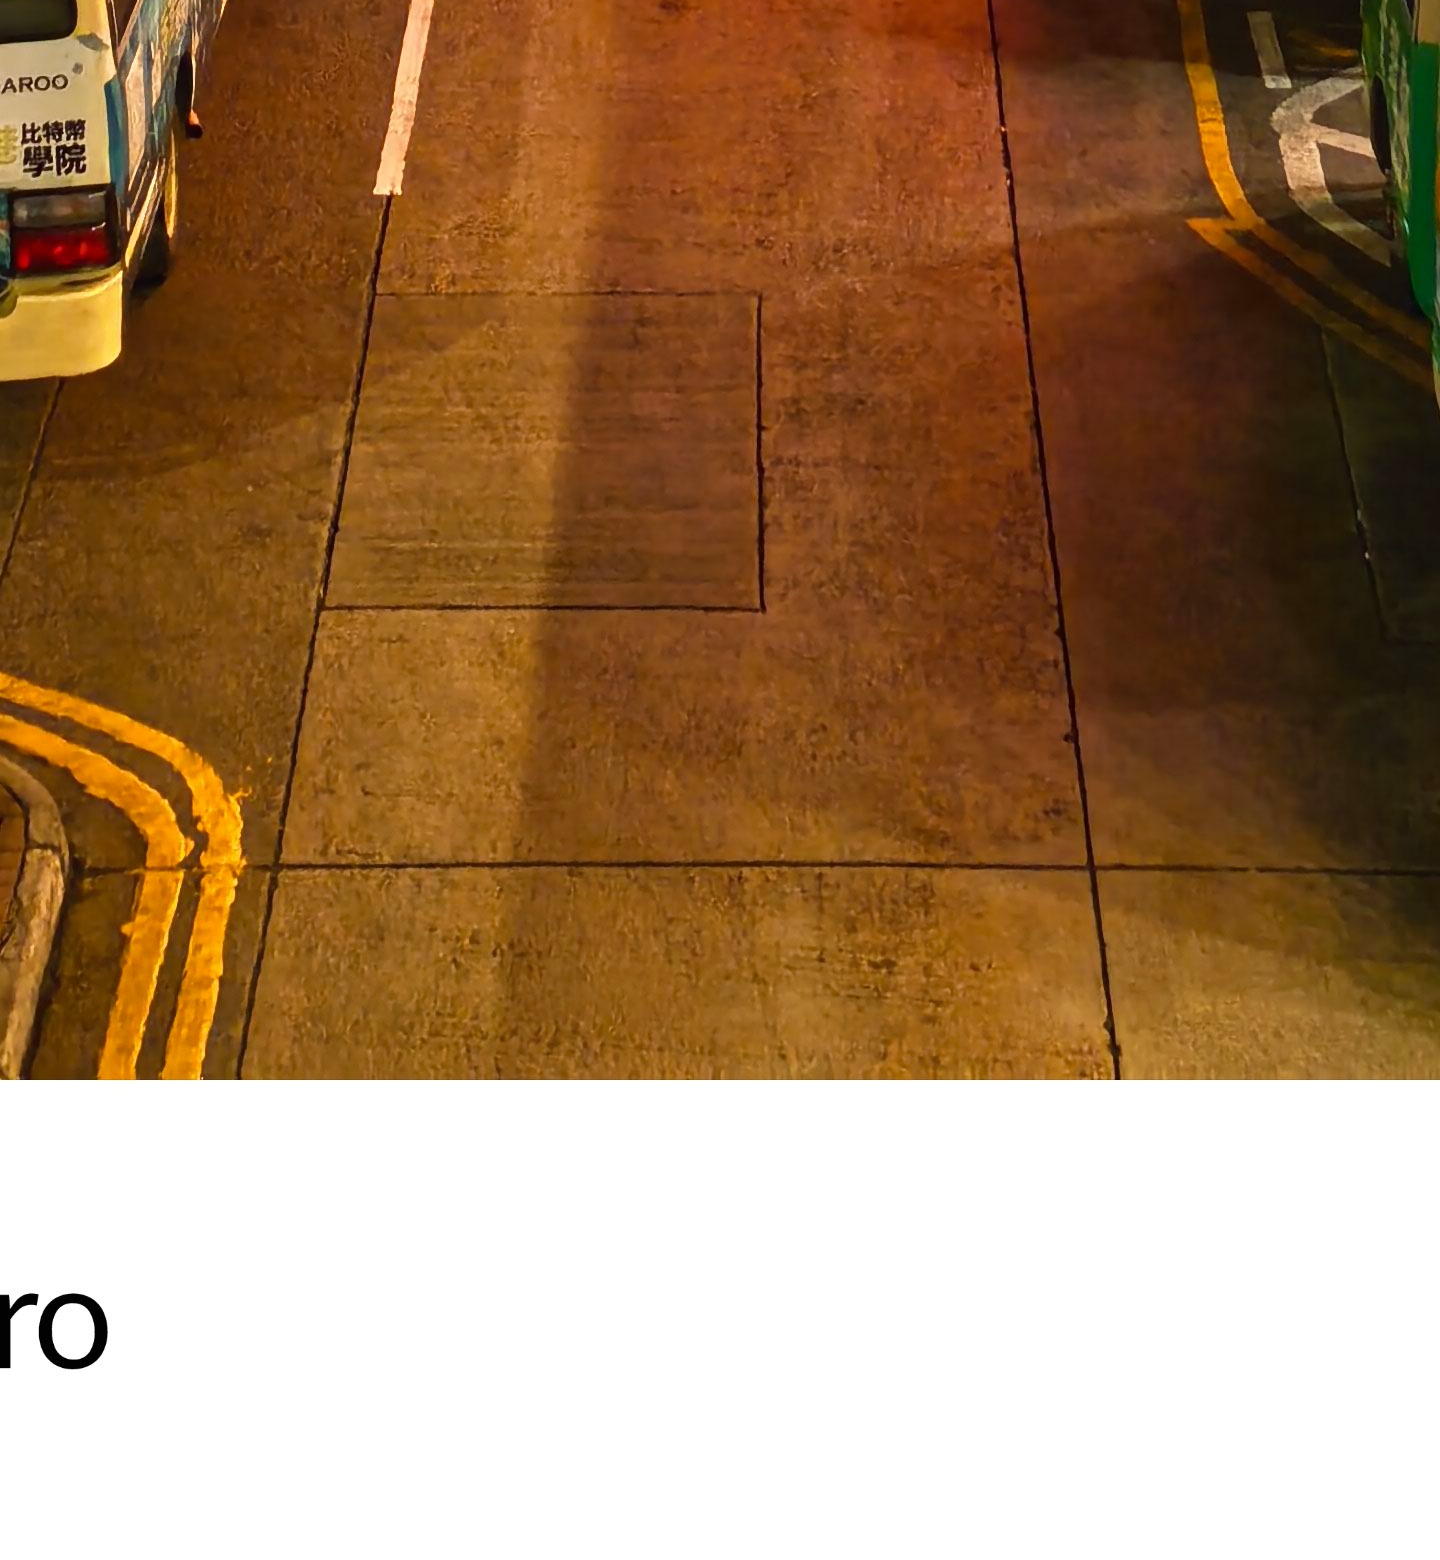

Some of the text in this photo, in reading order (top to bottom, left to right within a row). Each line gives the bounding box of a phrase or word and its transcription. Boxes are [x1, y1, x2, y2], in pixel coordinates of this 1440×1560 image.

[21, 120, 87, 144] 比特幣
[22, 144, 87, 177] 學院
